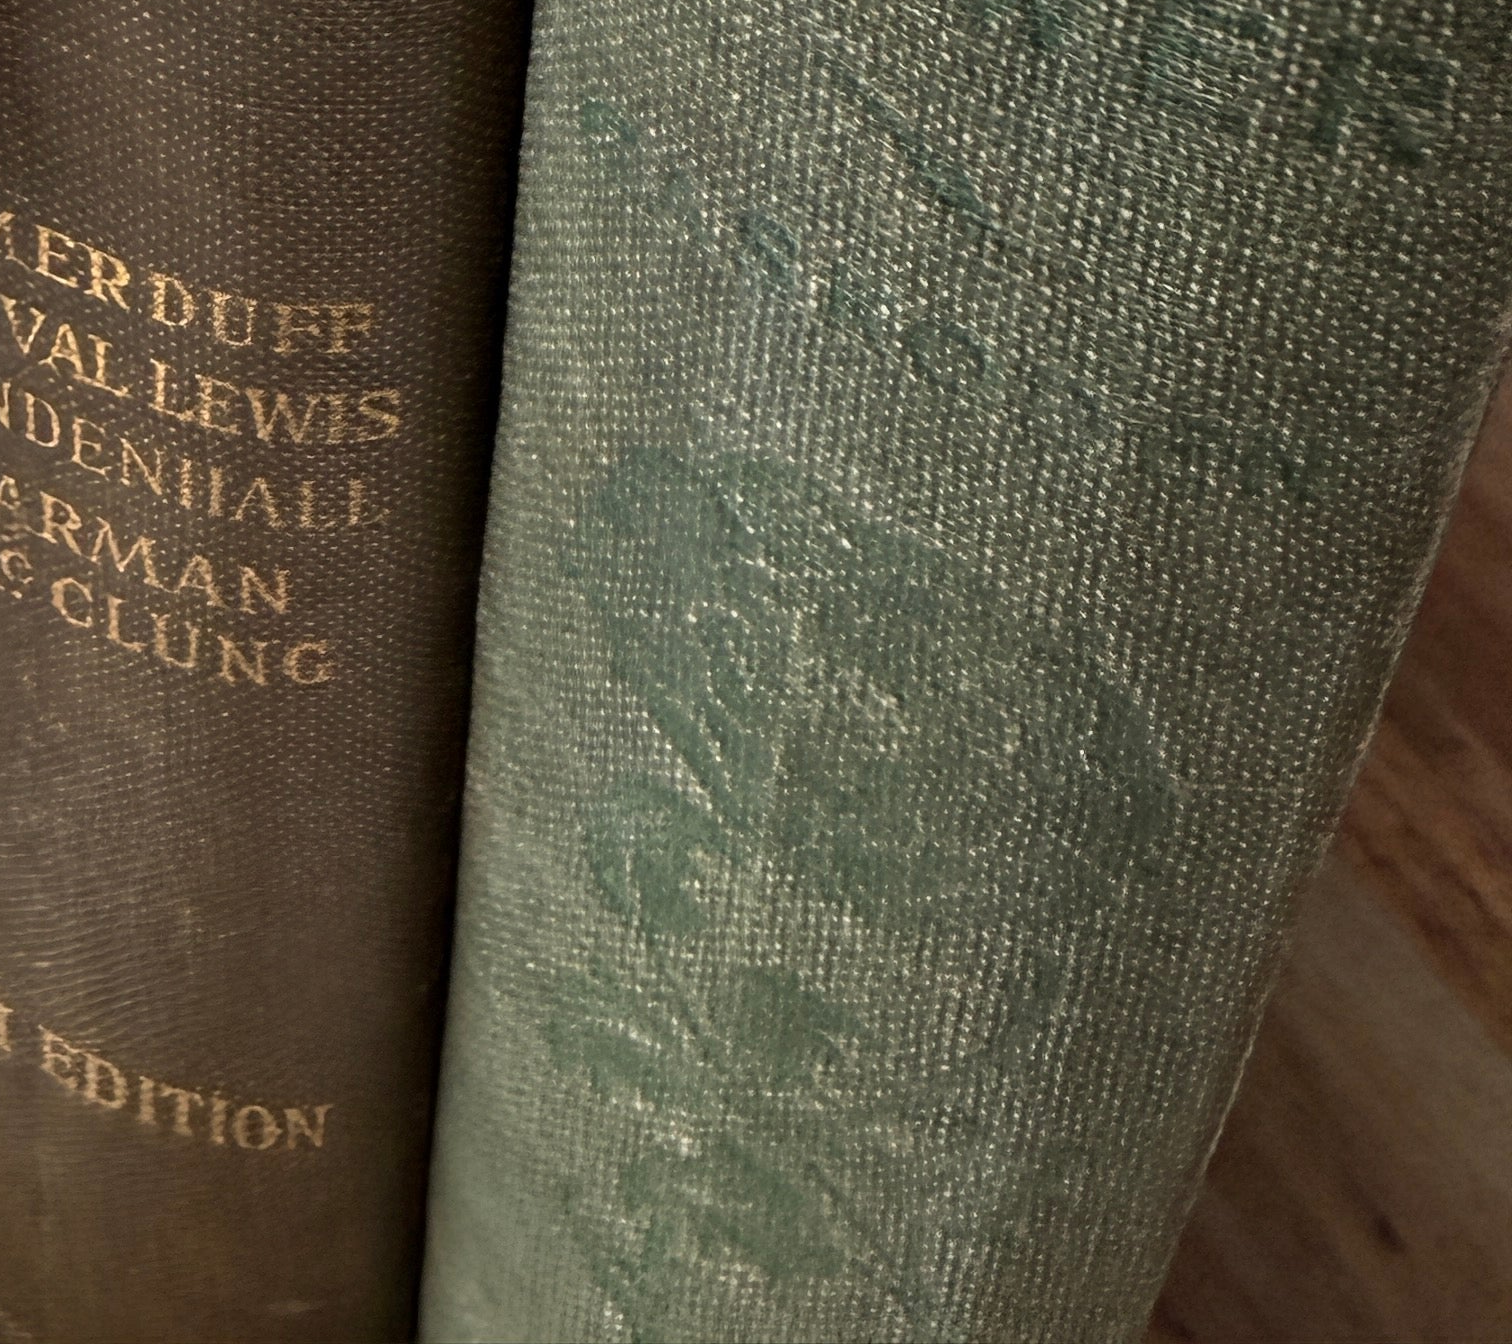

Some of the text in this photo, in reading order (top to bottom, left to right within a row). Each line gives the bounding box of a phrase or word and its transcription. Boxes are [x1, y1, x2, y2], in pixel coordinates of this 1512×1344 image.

[149, 269, 375, 357] DUFF
[149, 356, 403, 446] LEWIS
[38, 1024, 335, 1151] EDITION
